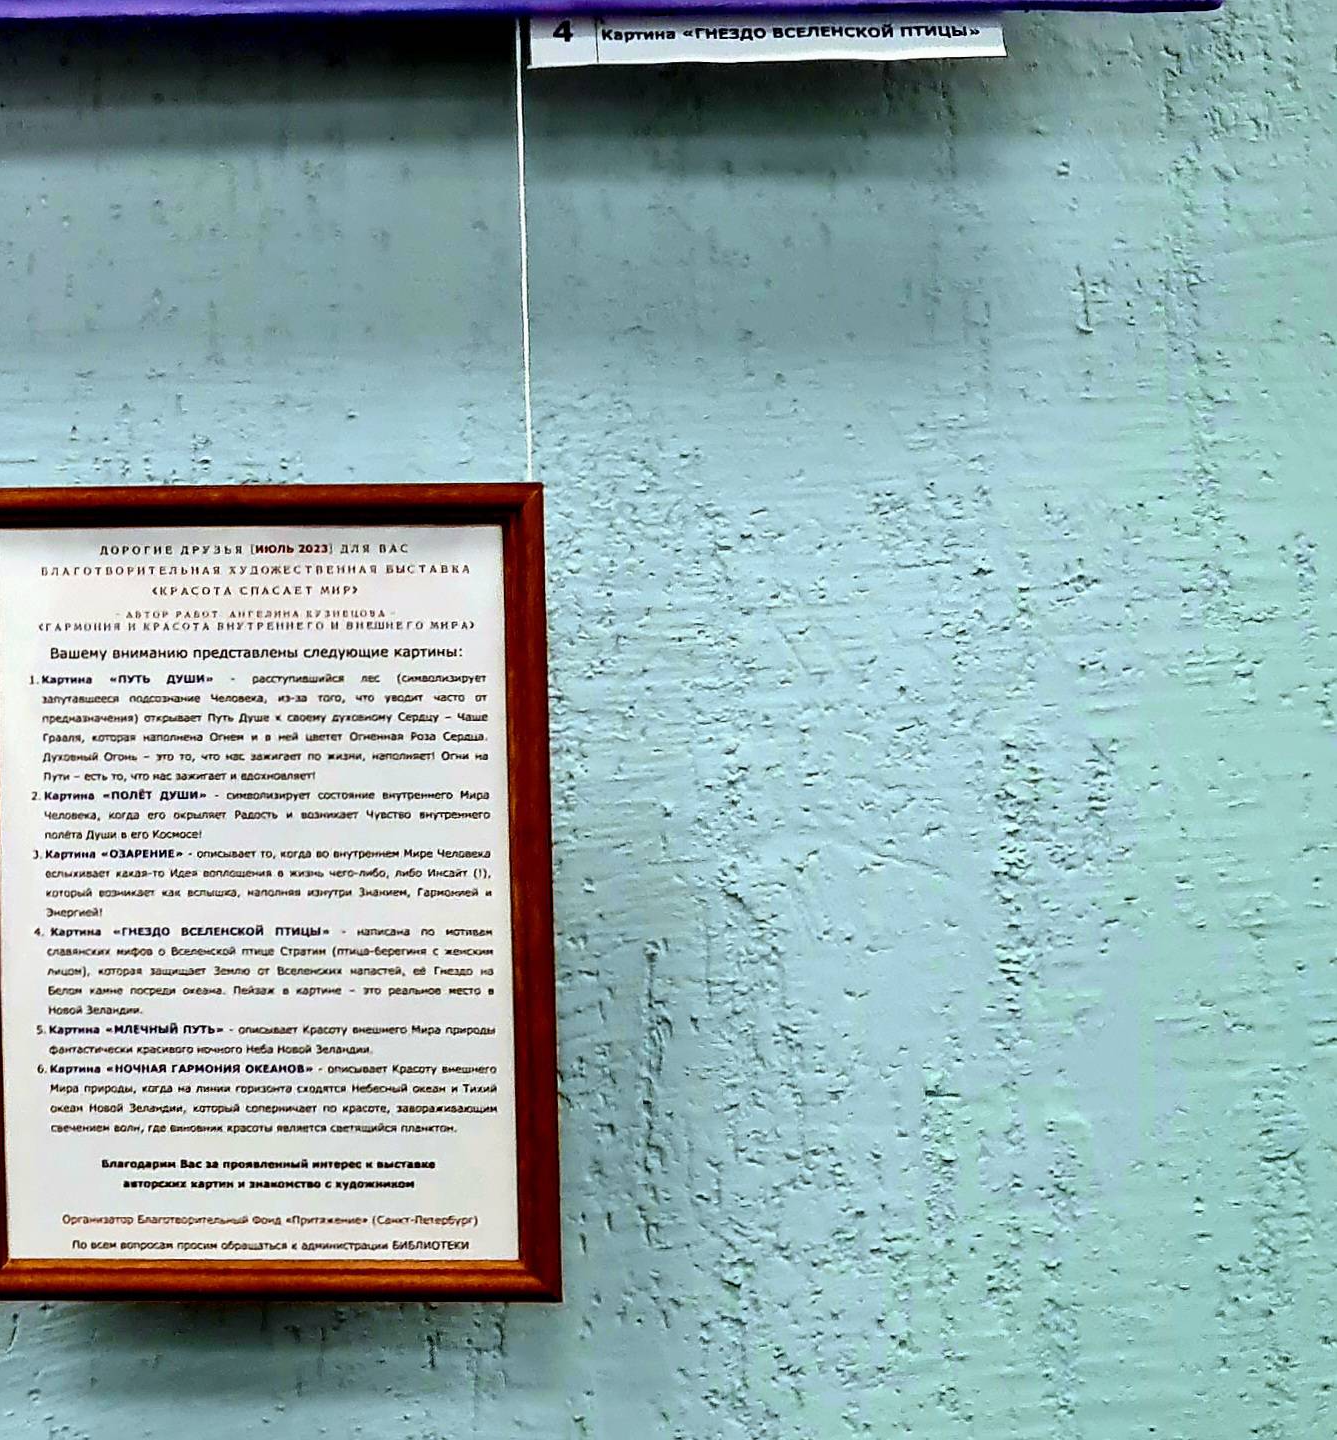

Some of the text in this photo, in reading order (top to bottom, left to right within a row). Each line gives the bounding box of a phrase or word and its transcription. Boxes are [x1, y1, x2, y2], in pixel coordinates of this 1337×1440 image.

[553, 20, 574, 42] 4
[602, 28, 676, 43] Картина
[772, 23, 894, 39] ВСЕЛЕНСКОЙ
